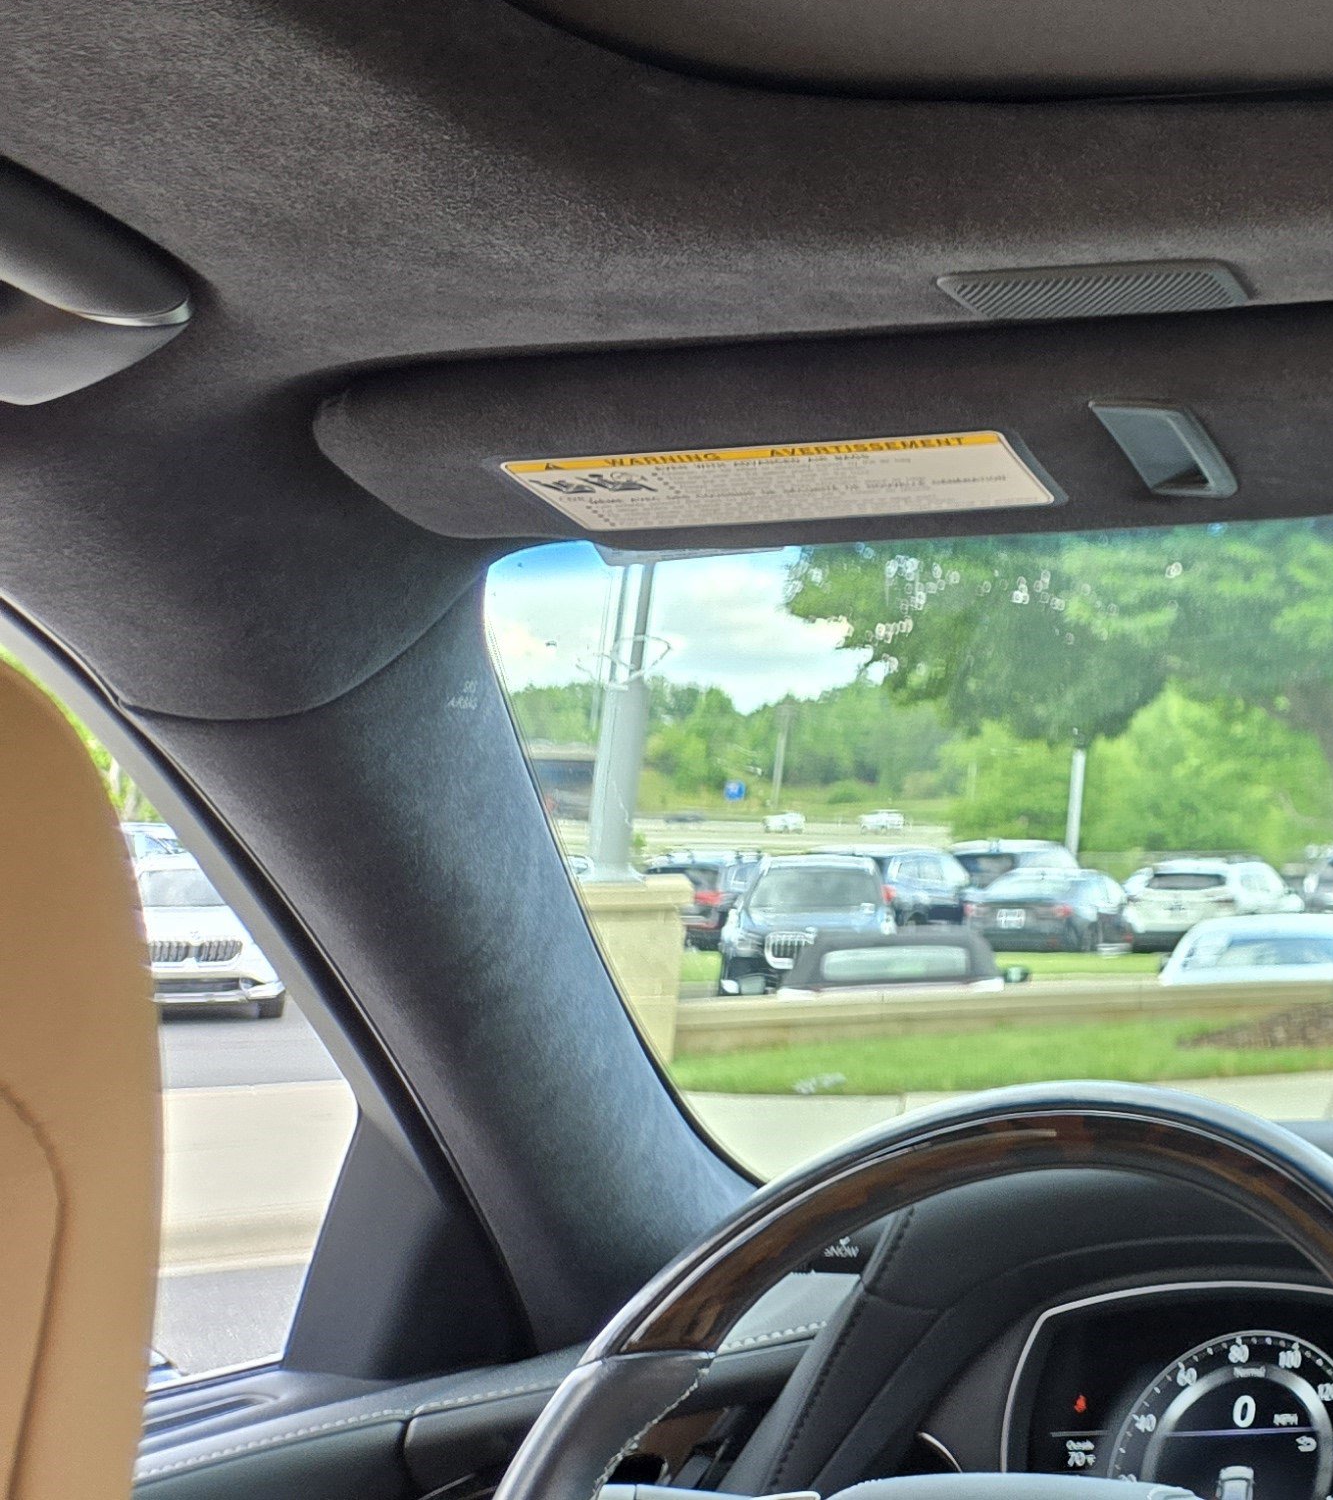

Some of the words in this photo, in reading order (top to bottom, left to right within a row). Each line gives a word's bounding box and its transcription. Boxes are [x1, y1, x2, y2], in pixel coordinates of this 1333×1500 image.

[604, 453, 721, 467] WARNING
[770, 437, 965, 457] AVERTISSEMENT
[1227, 1344, 1250, 1363] 80
[1278, 1350, 1302, 1369] 100
[1176, 1366, 1198, 1387] 60
[1233, 1395, 1256, 1428] 0
[1135, 1413, 1157, 1433] 40
